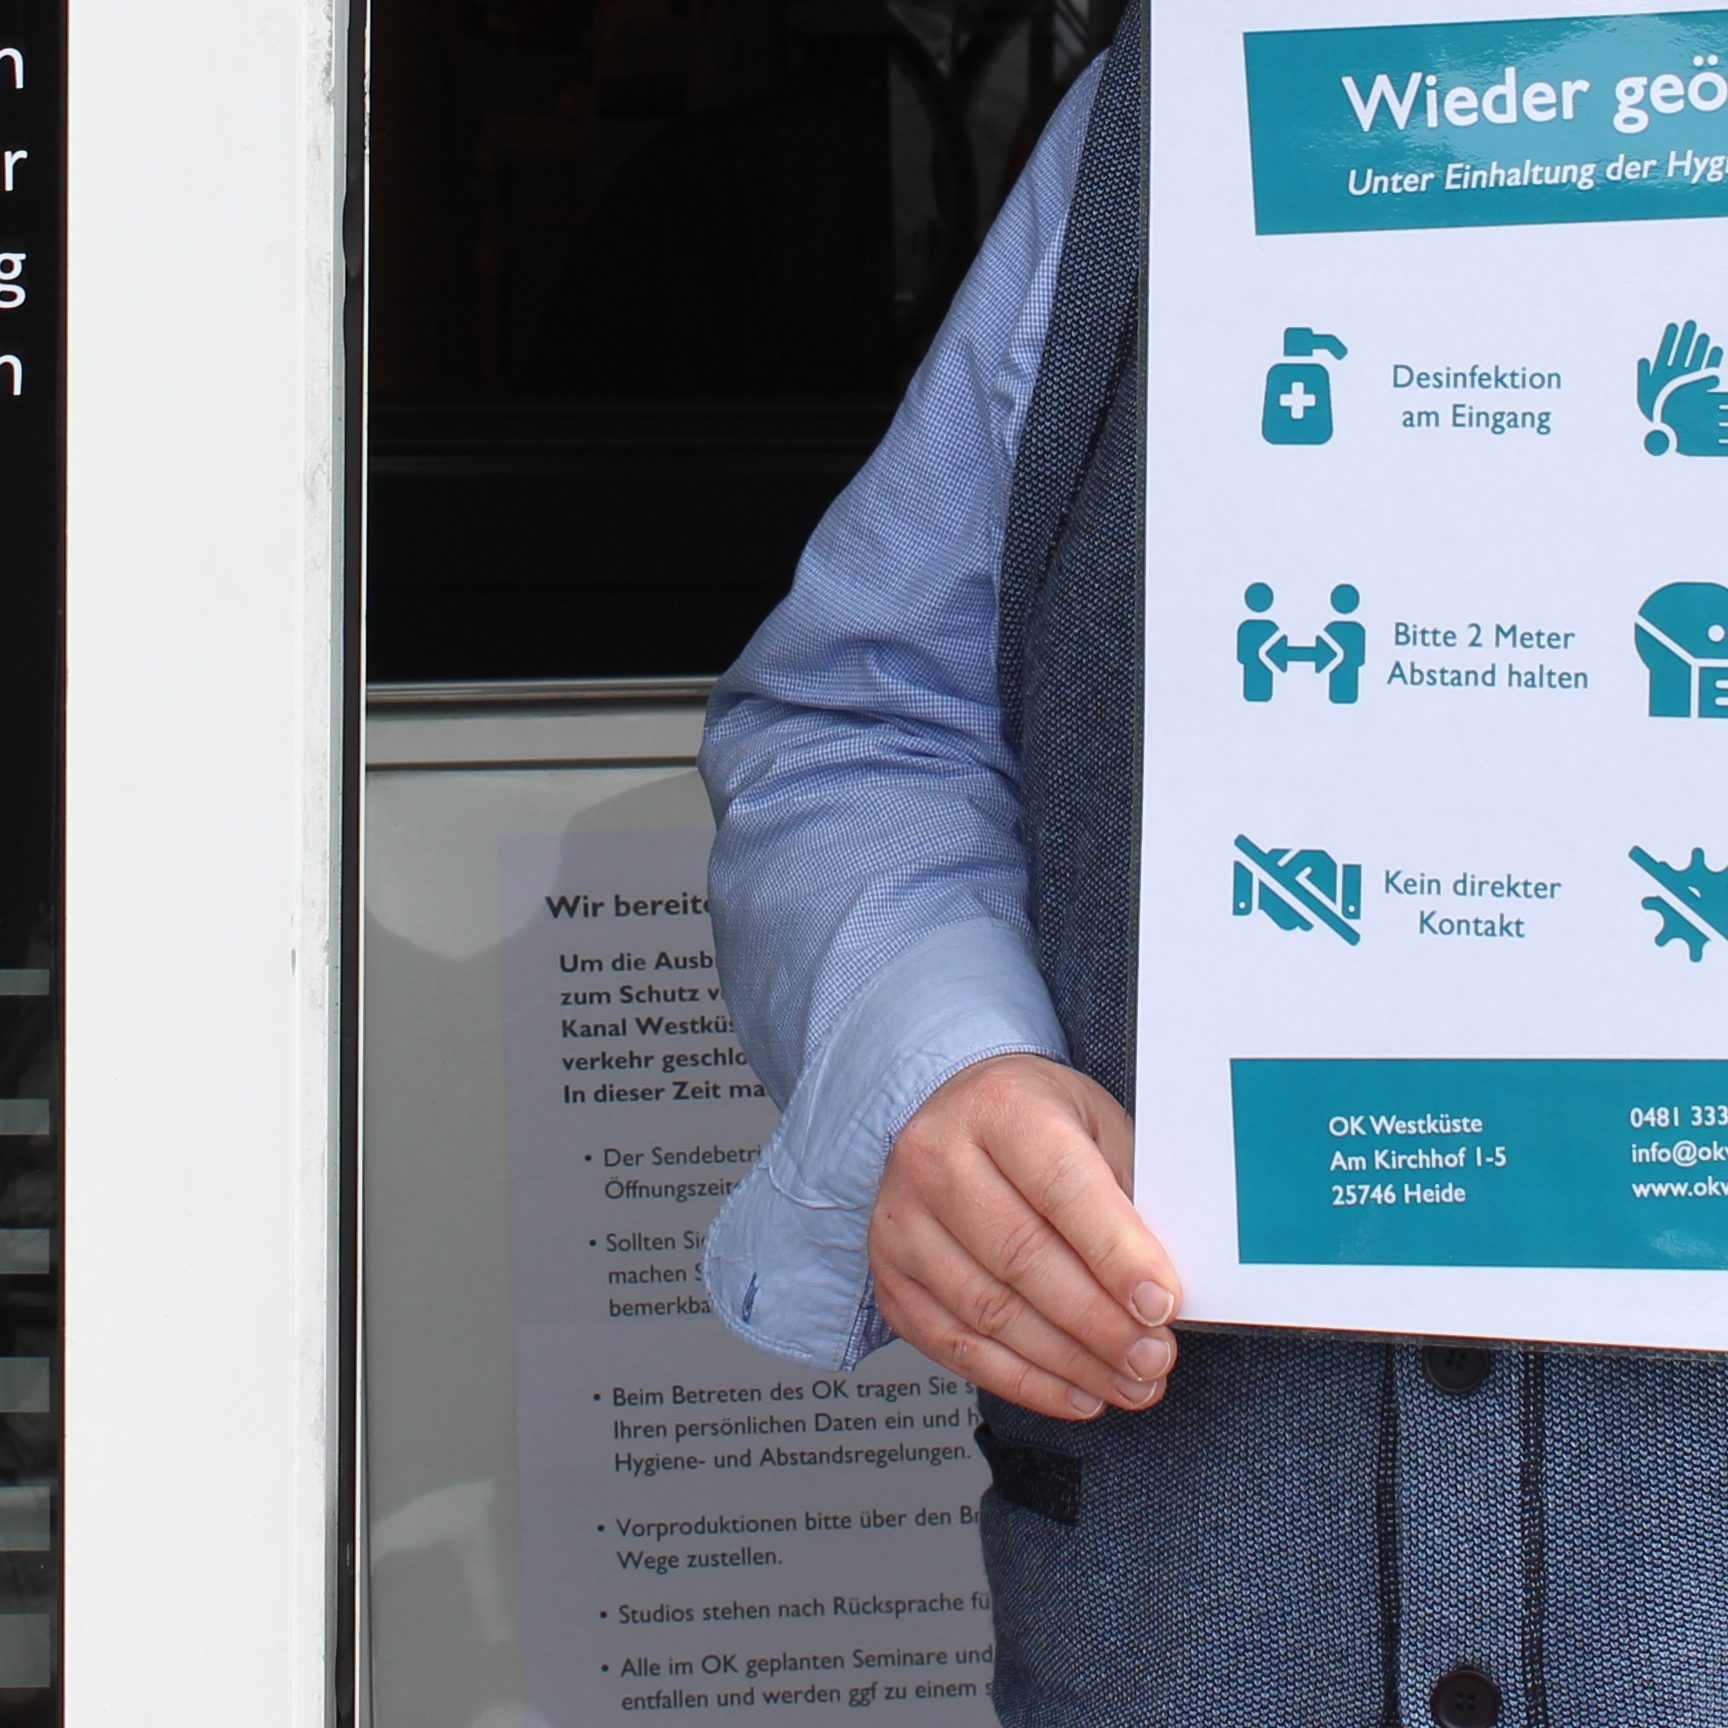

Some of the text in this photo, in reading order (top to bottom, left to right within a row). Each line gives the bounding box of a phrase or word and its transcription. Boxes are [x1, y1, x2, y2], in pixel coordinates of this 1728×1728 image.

[1342, 67, 1590, 131] Wieder
[1349, 169, 1435, 195] Unter
[1446, 160, 1596, 189] Einhaltung
[1607, 154, 1657, 180] der
[1393, 365, 1561, 389] Desinfektion
[1403, 404, 1551, 435] am Eingang
[1395, 622, 1575, 649] Bitte 2 Meter
[1387, 661, 1587, 688] Abstand halten
[1385, 870, 1561, 899] Kein direkter
[546, 895, 604, 918] Wir
[1420, 911, 1524, 937] Kontakt
[560, 951, 713, 972] Um die Ausb
[561, 992, 611, 1005] zum
[620, 985, 699, 1003] Schutz
[562, 1013, 735, 1038] Kanal Westküs
[562, 1046, 748, 1073] verkehr geschlo
[564, 1081, 766, 1103] In dieser Zeit ma
[1330, 1114, 1482, 1136] OK Westküste
[1631, 1107, 1678, 1127] 0481
[604, 1145, 760, 1167] Der Sendebetri
[1330, 1147, 1506, 1171] Am Kirchhof 1-5
[1333, 1182, 1465, 1205] 25746 Heide
[607, 1233, 675, 1252] Sollten
[609, 1265, 686, 1284] machen
[610, 1296, 711, 1317] bemerkba
[613, 1388, 663, 1406] Beim
[673, 1386, 761, 1404] Betreten
[770, 1382, 804, 1400] des
[812, 1380, 848, 1399] OK
[857, 1383, 920, 1402] tragen
[929, 1376, 957, 1395] Sie
[614, 1421, 666, 1439] Ihren
[676, 1415, 806, 1443] persönlichen
[815, 1413, 876, 1432] Daten
[885, 1412, 914, 1429] ein
[923, 1408, 959, 1428] und
[615, 1443, 970, 1477] Hygiene- und Abstandsregelungen.
[616, 1515, 796, 1542] Vorproduktionen
[805, 1512, 851, 1530] bitte
[860, 1510, 907, 1528] über
[915, 1508, 951, 1526] den
[617, 1547, 782, 1575] Wege zustellen.
[619, 1592, 989, 1624] Studios stehen nach Rücksprache fü
[621, 1644, 993, 1678] Alle im OK geplanten Seminare und
[622, 1690, 708, 1710] entfallen
[717, 1687, 754, 1706] und
[763, 1685, 840, 1704] werden
[884, 1687, 906, 1700] zu
[915, 1681, 976, 1698] einem
